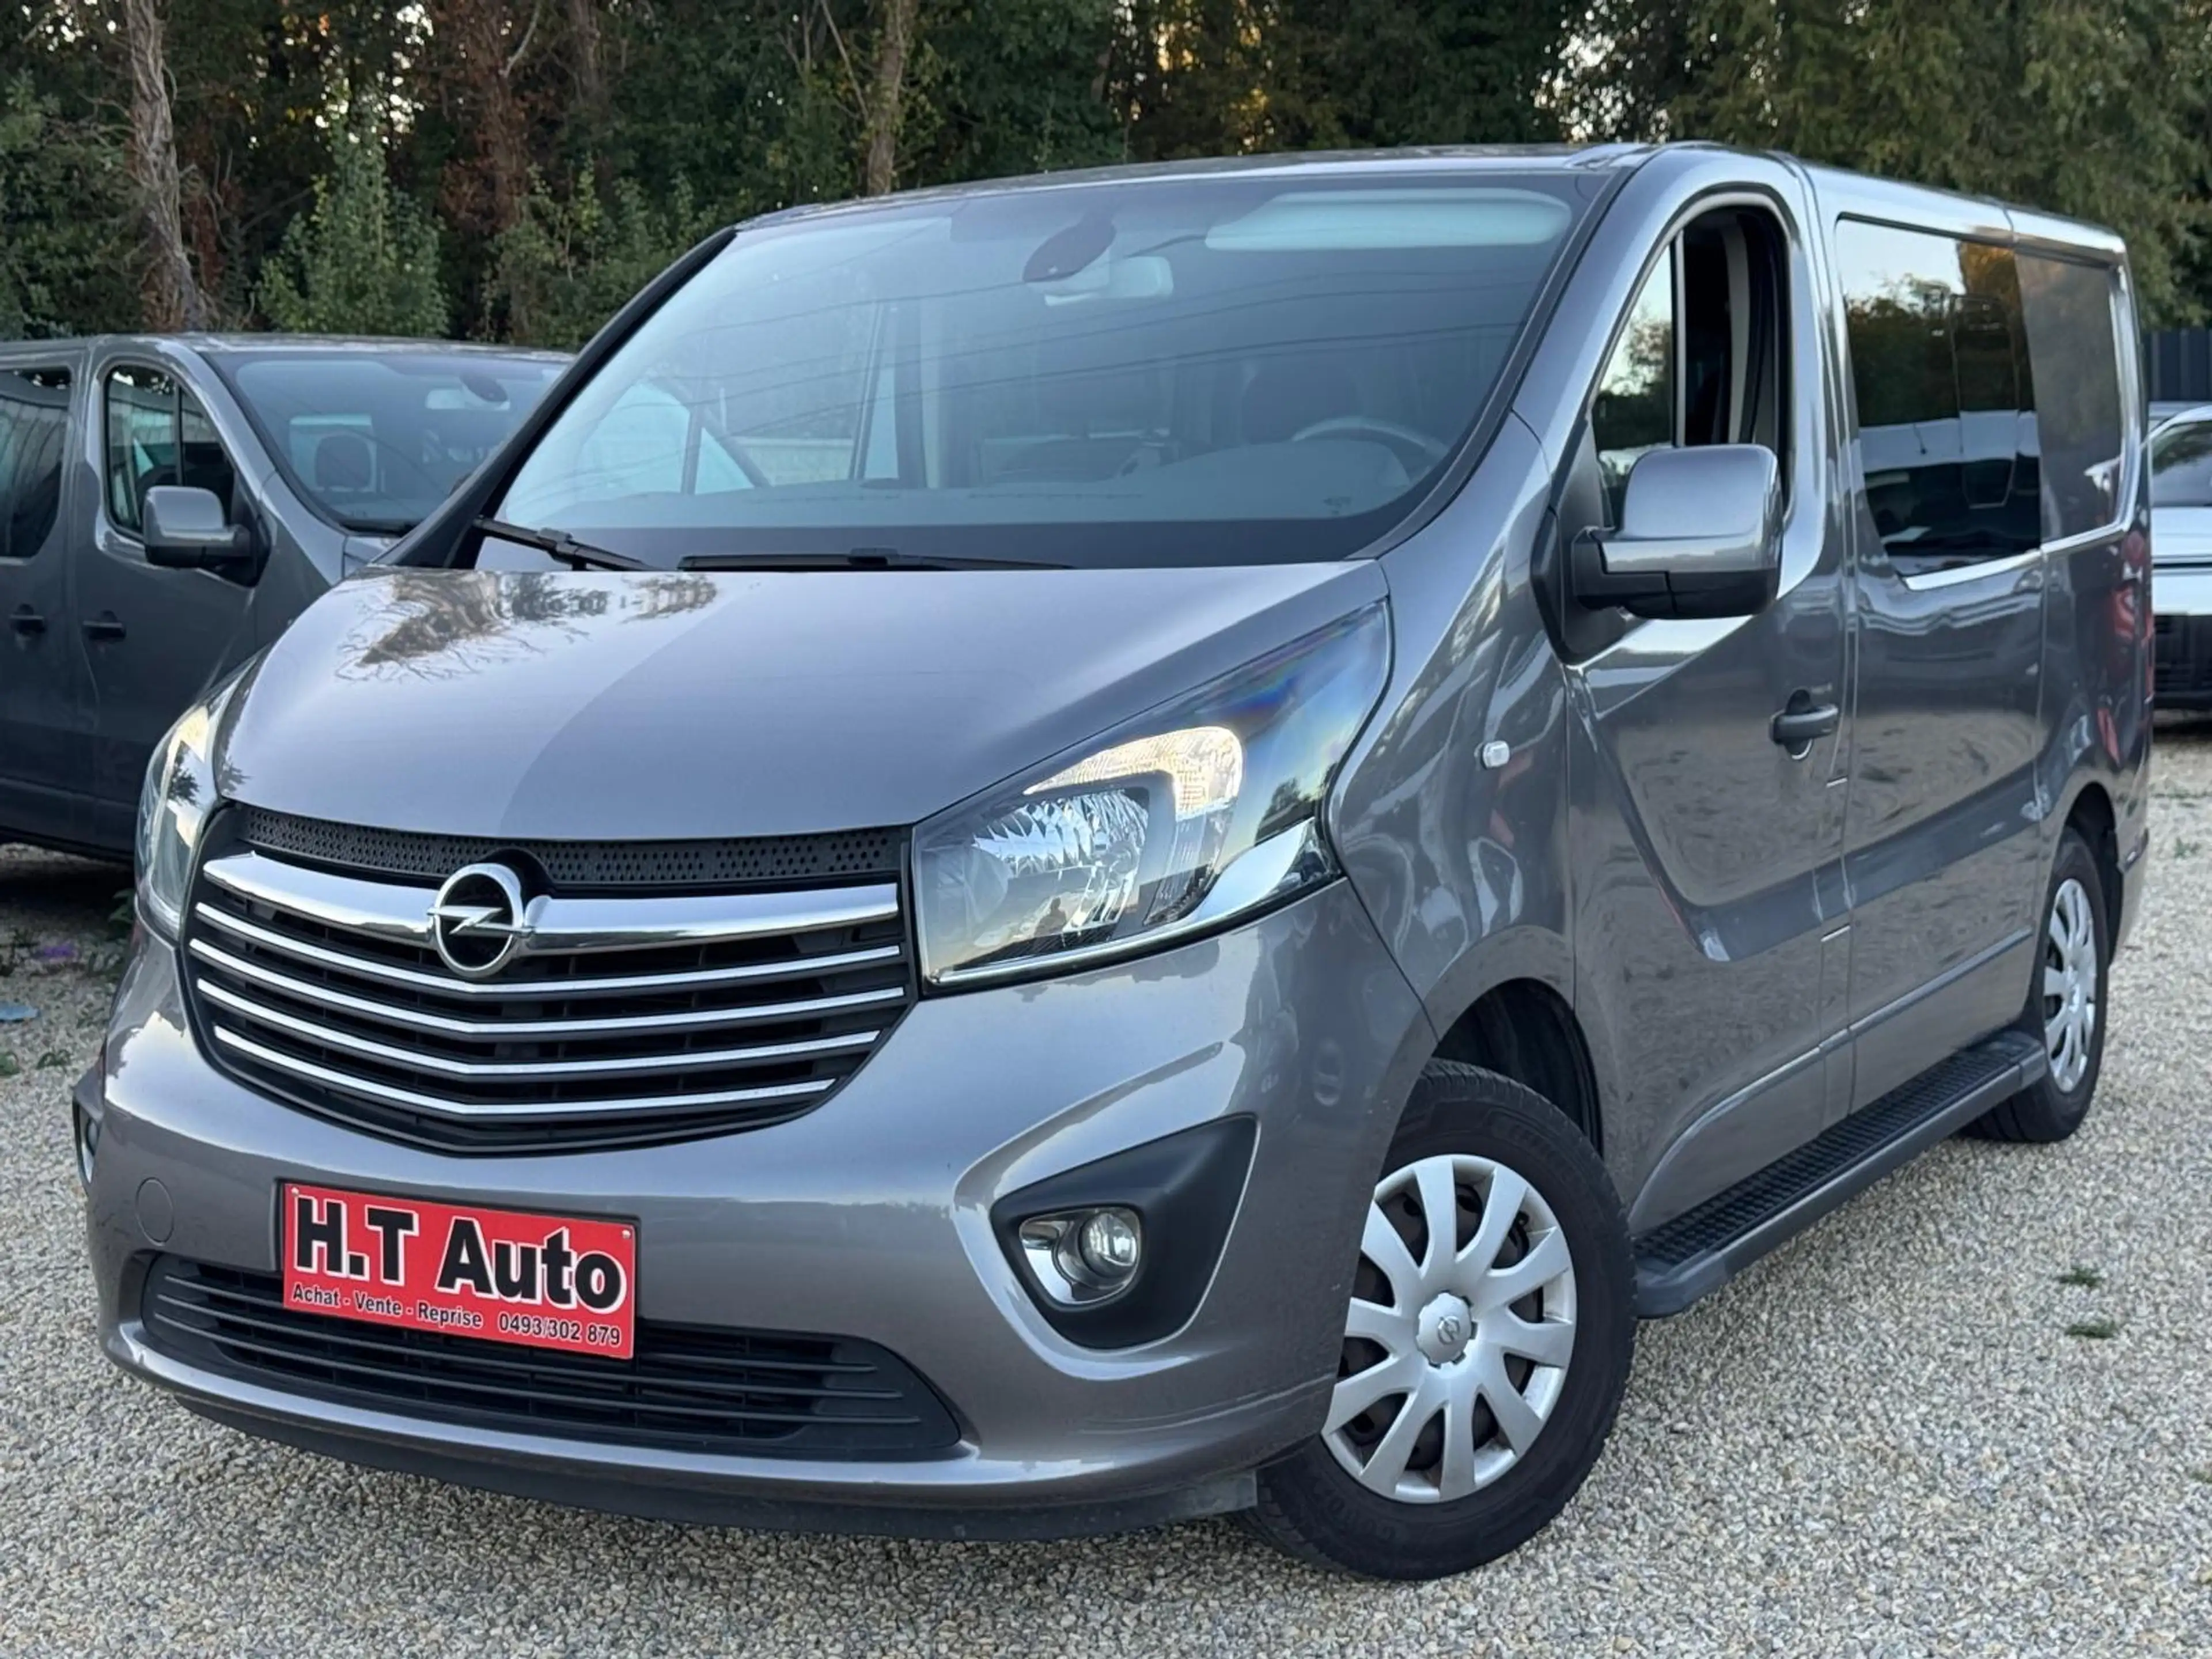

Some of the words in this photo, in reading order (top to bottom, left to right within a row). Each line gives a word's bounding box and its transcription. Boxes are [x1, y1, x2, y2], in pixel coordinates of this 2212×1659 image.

[294, 1195, 419, 1286] H.T
[434, 1216, 627, 1313] Auto
[292, 1283, 340, 1306] Achat
[354, 1290, 403, 1316] Vente
[417, 1301, 482, 1329] Reprise
[587, 1324, 622, 1346] 879
